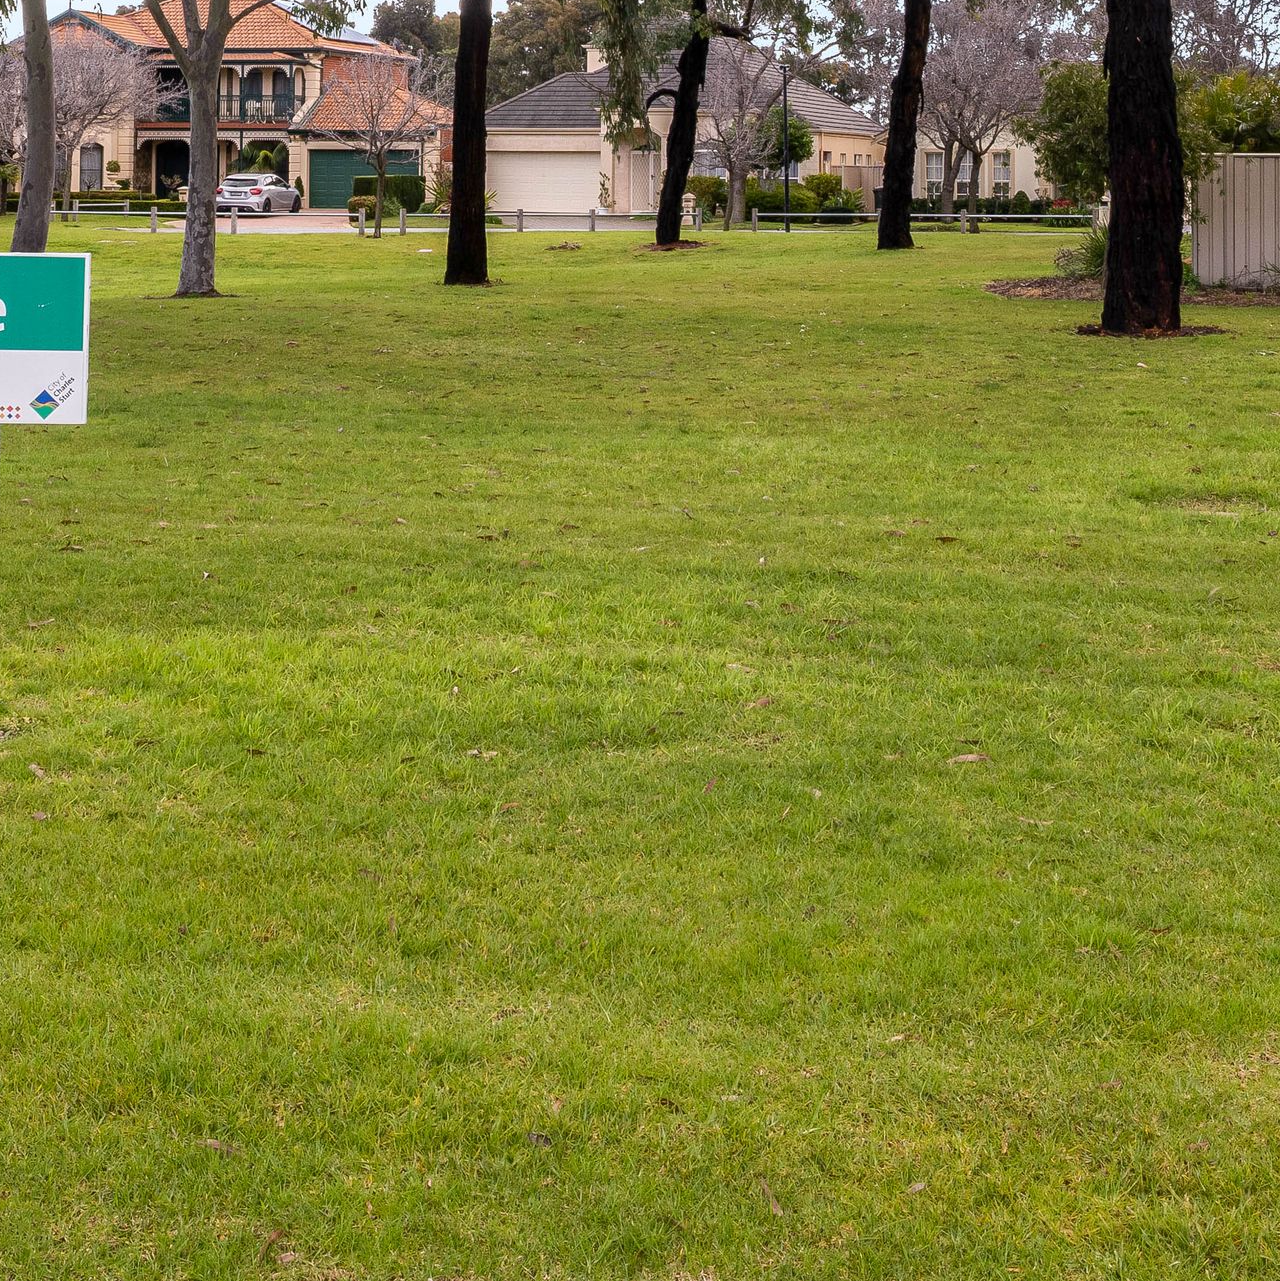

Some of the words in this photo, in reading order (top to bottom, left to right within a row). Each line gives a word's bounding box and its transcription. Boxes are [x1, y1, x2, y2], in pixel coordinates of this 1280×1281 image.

[48, 380, 61, 391] City
[60, 371, 67, 381] of
[53, 377, 75, 397] Charles
[58, 388, 75, 403] Sturt
